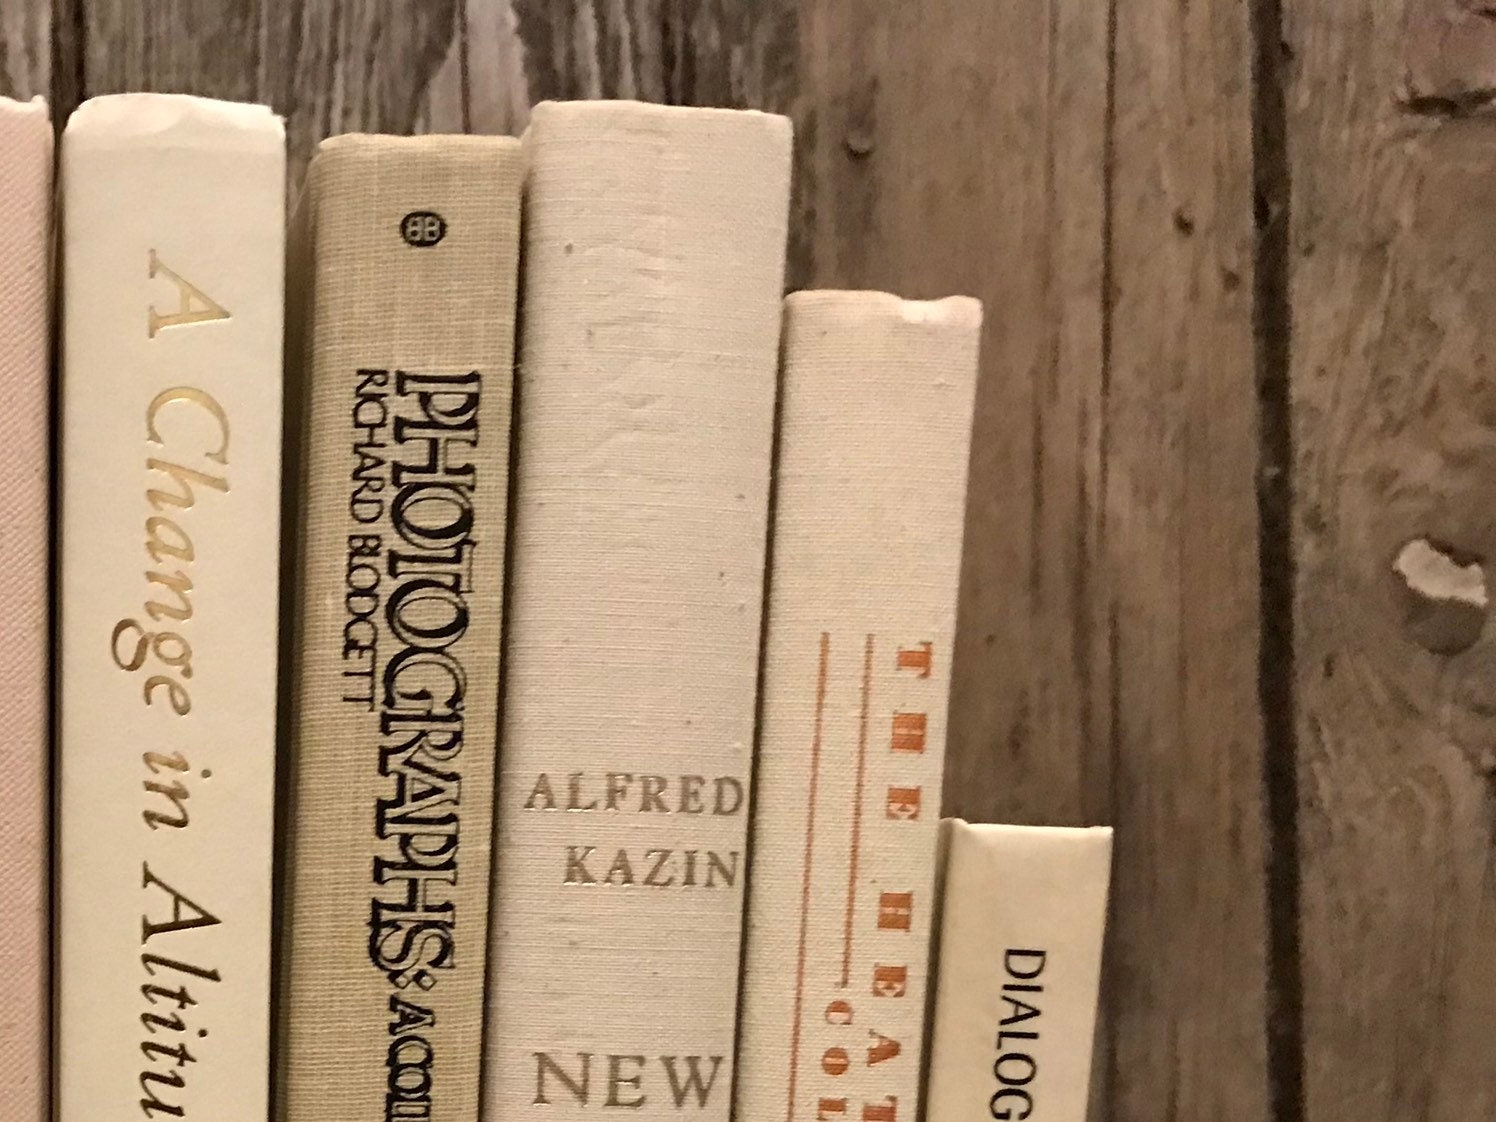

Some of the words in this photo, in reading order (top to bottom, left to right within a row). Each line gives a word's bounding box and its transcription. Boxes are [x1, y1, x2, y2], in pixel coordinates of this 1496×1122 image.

[148, 249, 232, 339] A
[348, 368, 389, 524] RICHARD
[111, 385, 231, 717] Change
[340, 534, 381, 713] BLODGETT
[885, 641, 933, 821] THE
[143, 751, 212, 832] in
[523, 771, 744, 813] ALFRED
[562, 846, 739, 889] KAZIN
[531, 1052, 724, 1108] NEW
